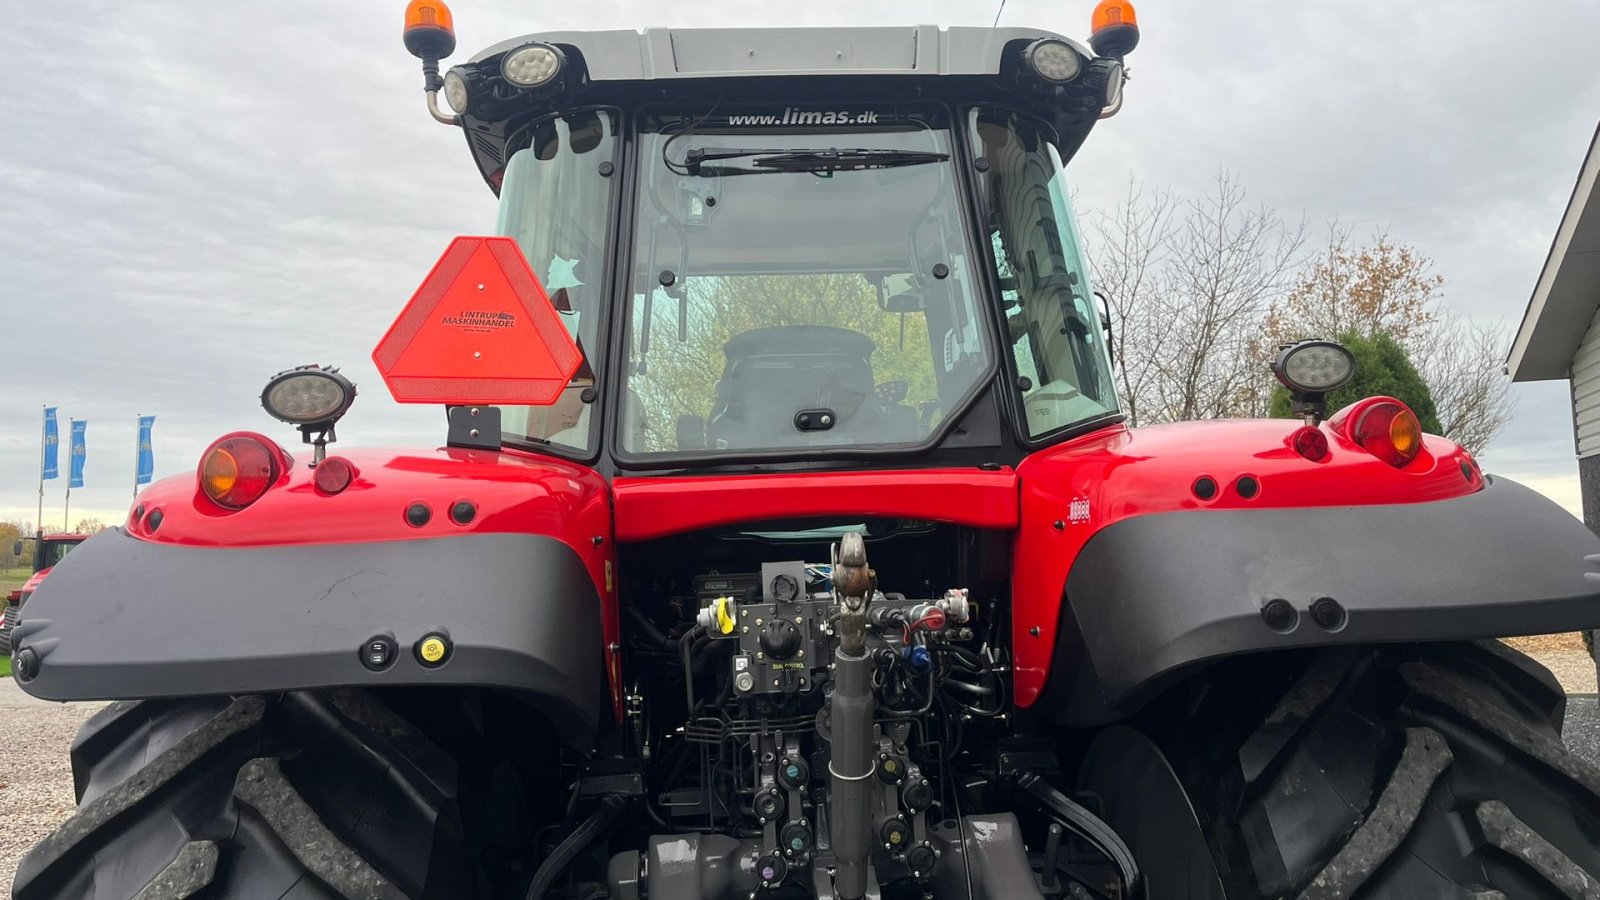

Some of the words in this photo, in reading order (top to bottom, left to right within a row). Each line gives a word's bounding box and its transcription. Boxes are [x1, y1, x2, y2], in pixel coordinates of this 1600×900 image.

[728, 107, 879, 126] www.limas.dk
[460, 310, 499, 320] LINTRUP
[442, 317, 516, 328] MASKINHANDEL
